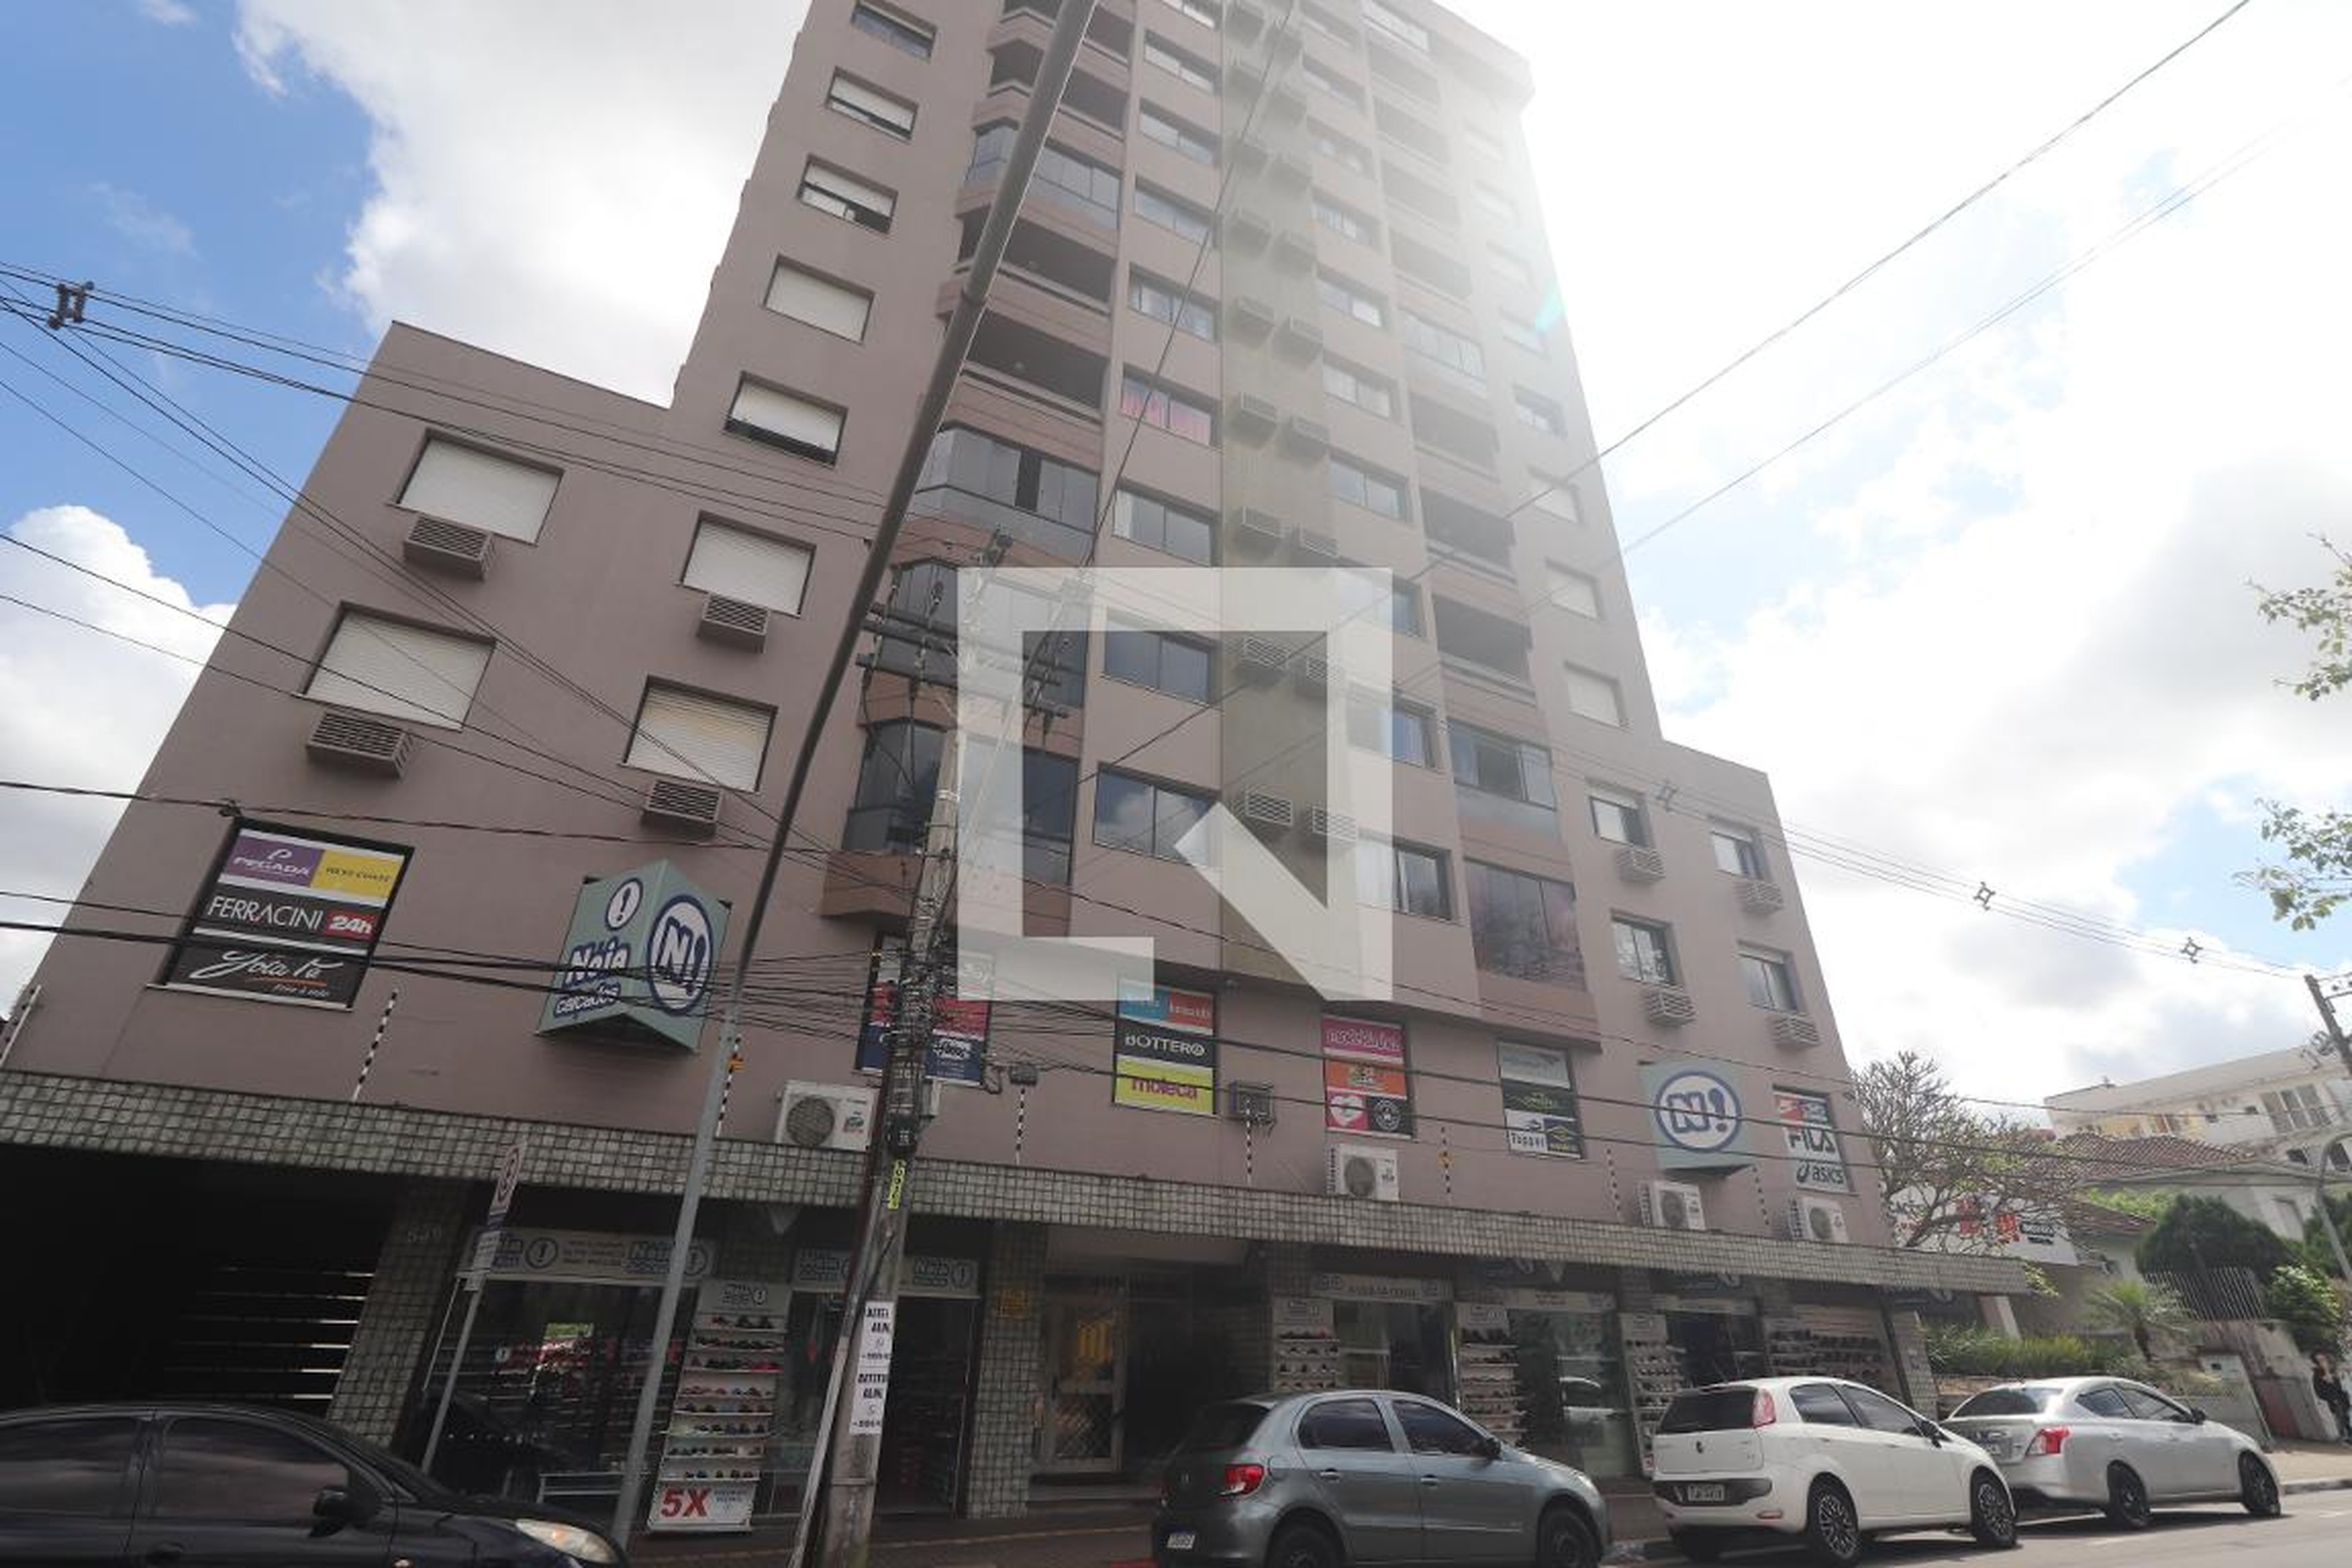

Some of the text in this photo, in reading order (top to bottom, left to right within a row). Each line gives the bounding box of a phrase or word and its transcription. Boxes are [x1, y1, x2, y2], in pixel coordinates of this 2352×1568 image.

[208, 895, 372, 935] FERRACINI 24h
[1124, 1033, 1206, 1057] BOTTERO
[1133, 1078, 1197, 1099] moleca
[1811, 1164, 1844, 1185] asics
[662, 1488, 709, 1517] 5X
